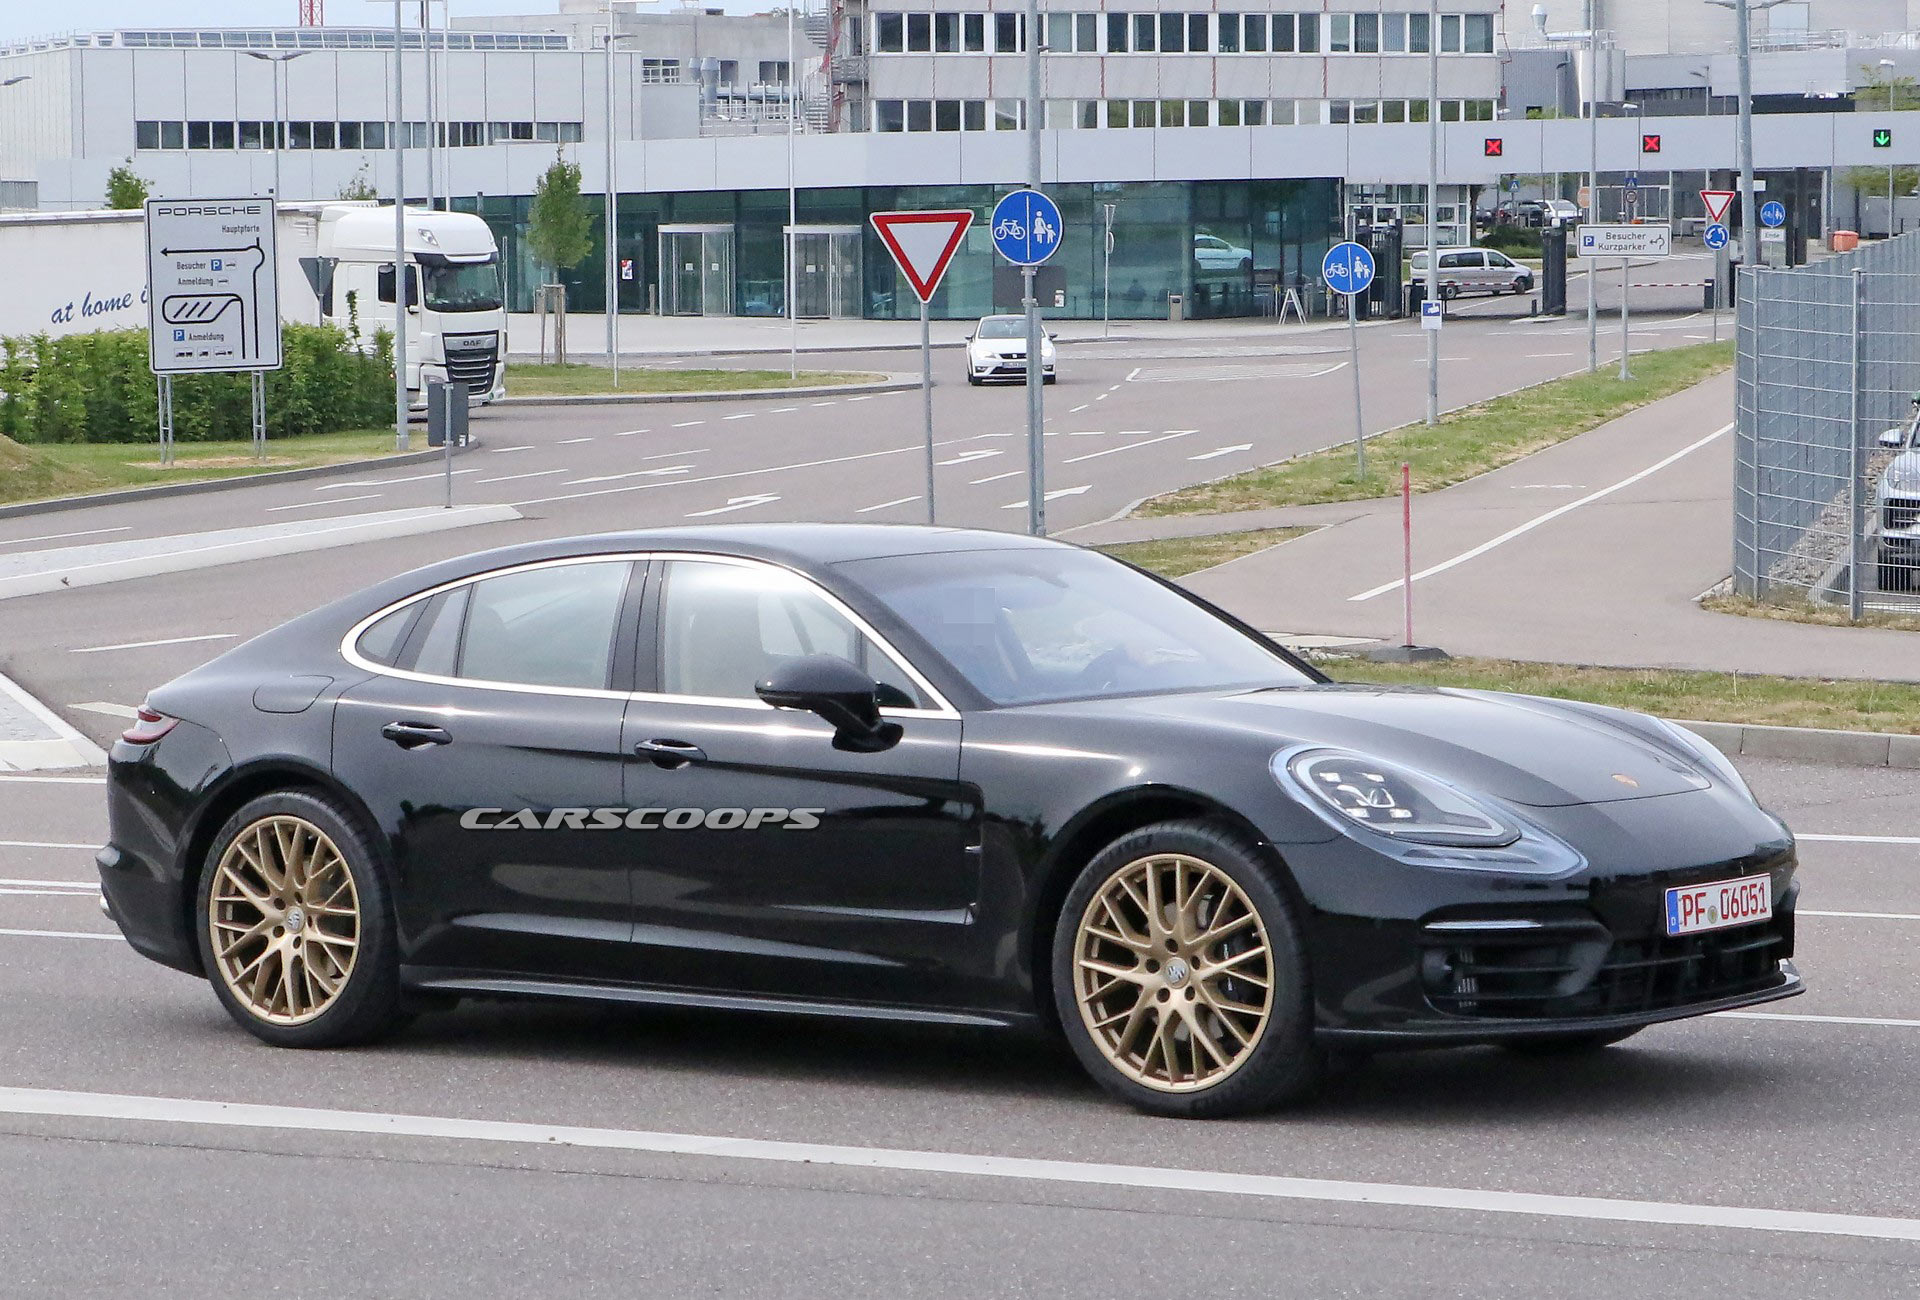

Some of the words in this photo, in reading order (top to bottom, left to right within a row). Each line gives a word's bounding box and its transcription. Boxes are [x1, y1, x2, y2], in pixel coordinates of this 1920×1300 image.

[158, 206, 261, 216] PORSCHE
[222, 225, 260, 234] Hauptpforte
[1605, 231, 1647, 240] Besucher
[1598, 243, 1647, 251] Kurzparker
[176, 261, 206, 270] Besucher
[178, 277, 214, 286] Anmeldung
[51, 302, 75, 324] at
[82, 291, 133, 317] home
[188, 333, 225, 342] Anmeldung
[1682, 892, 1707, 926] PF
[1720, 882, 1767, 920] 06051
